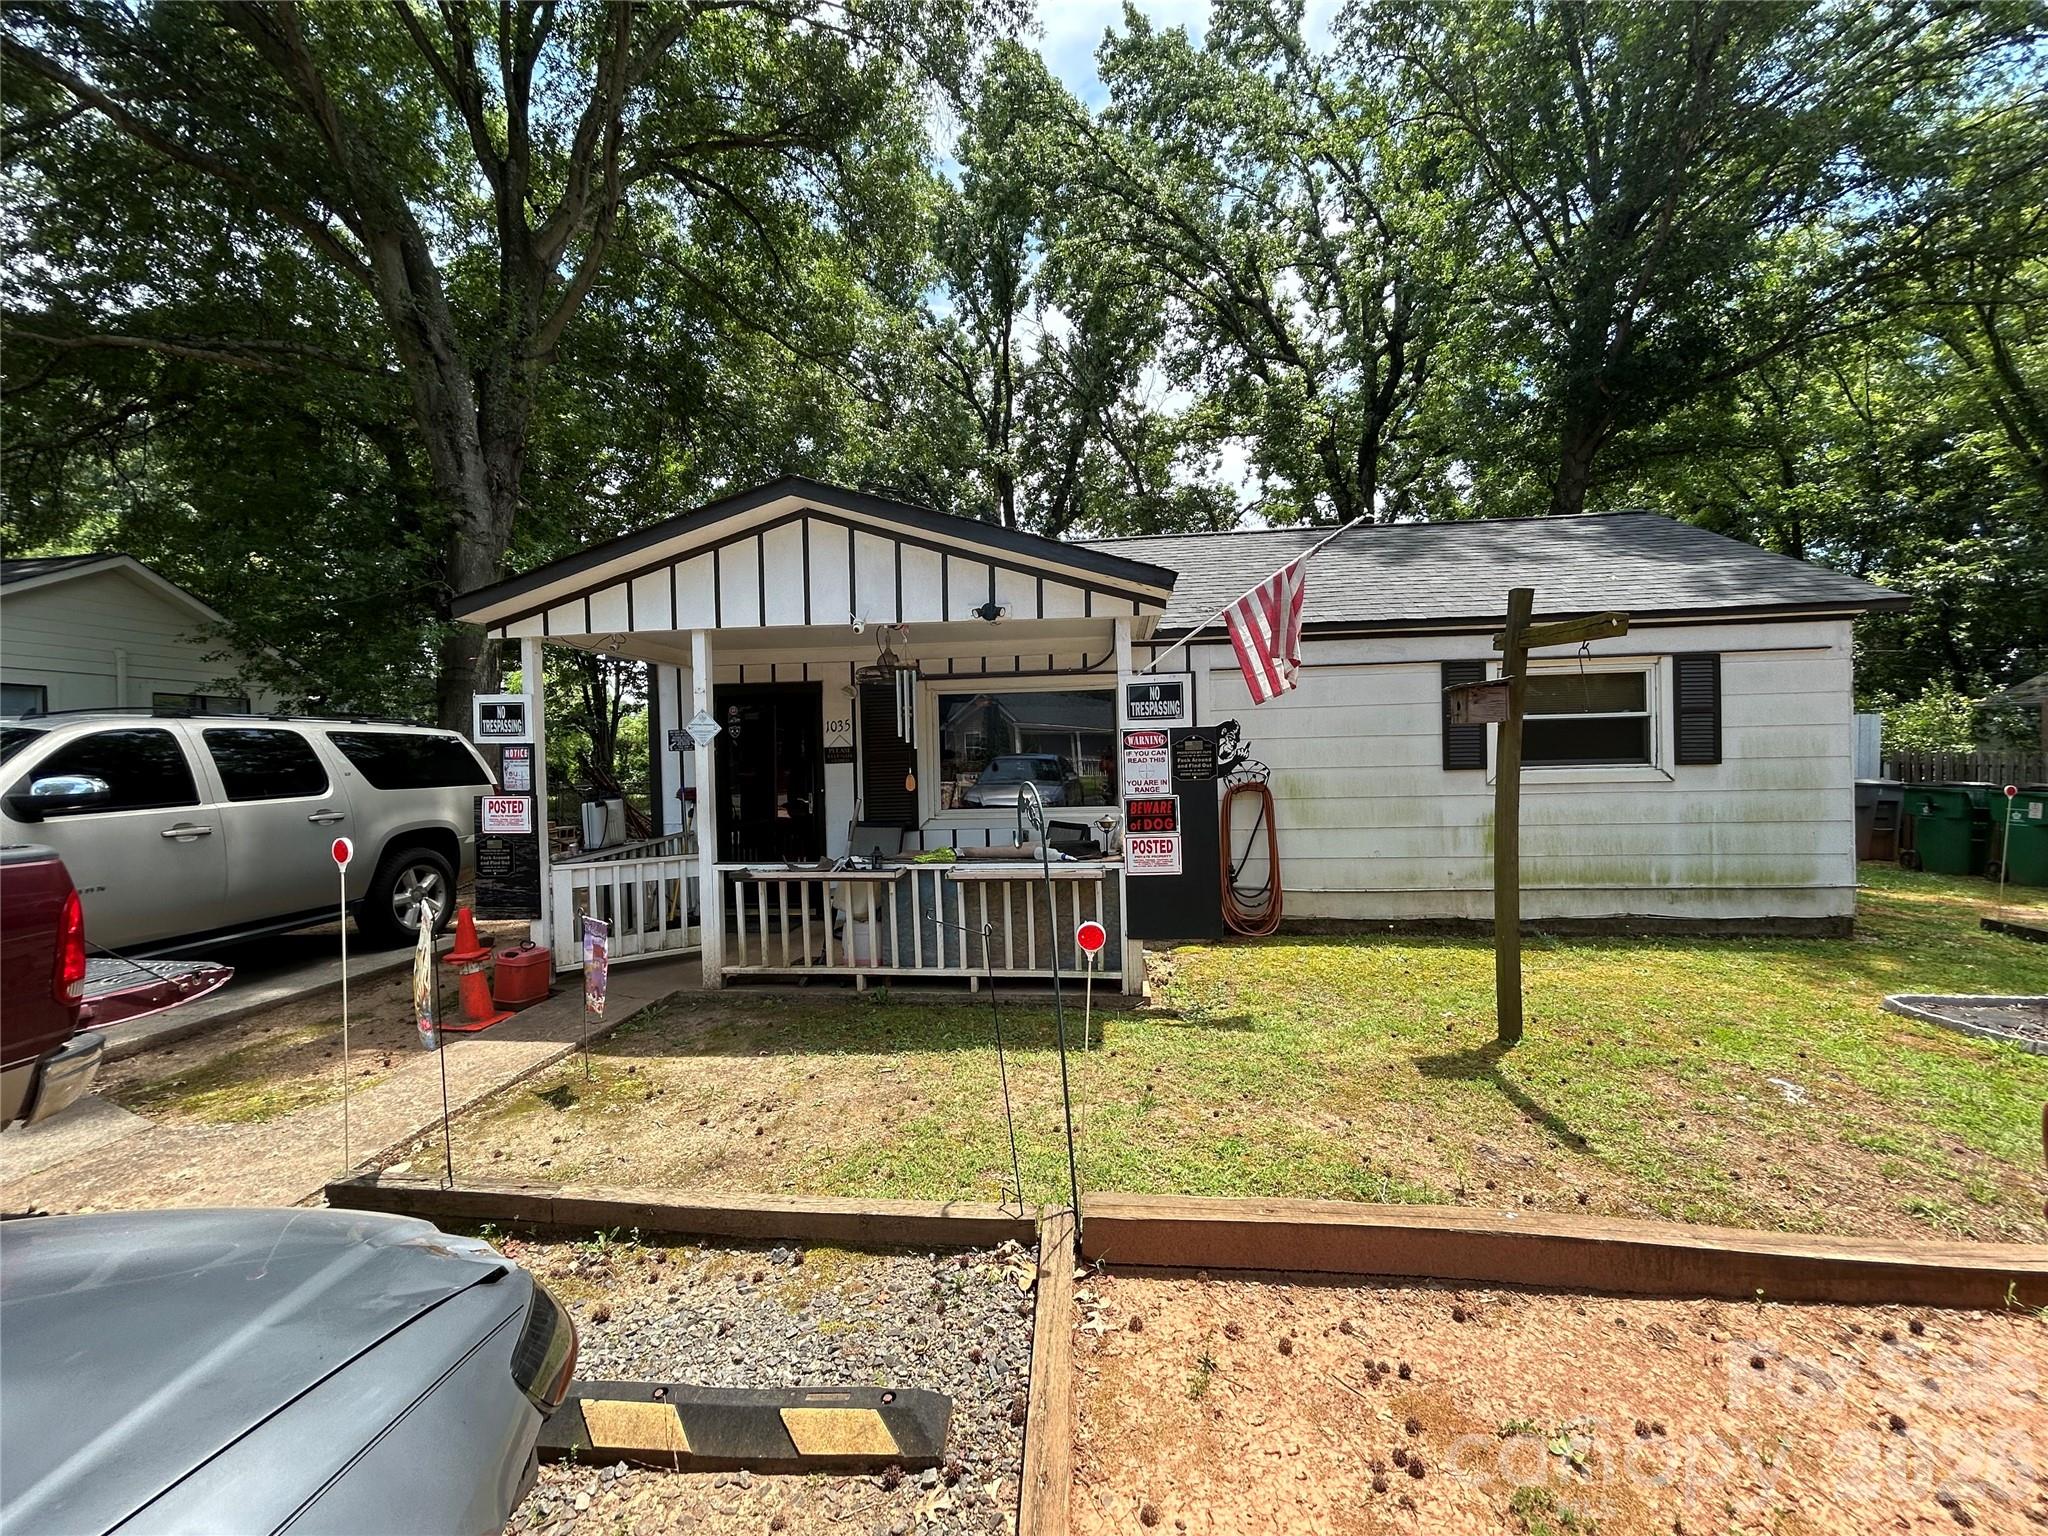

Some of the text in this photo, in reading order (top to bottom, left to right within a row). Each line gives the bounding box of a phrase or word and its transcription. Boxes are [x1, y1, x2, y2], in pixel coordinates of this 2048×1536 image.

[1149, 686, 1161, 701] NO
[496, 706, 506, 718] NO
[1130, 701, 1182, 717] TRESPASSING
[482, 719, 523, 734] TRESPASSING
[826, 719, 851, 733] 1035
[1127, 735, 1166, 746] WARNING
[505, 748, 528, 758] NOTICE
[488, 800, 524, 814] POSTED
[1130, 801, 1173, 814] BEWARE
[1130, 818, 1174, 831] of DOG
[1132, 839, 1174, 854] POSTED
